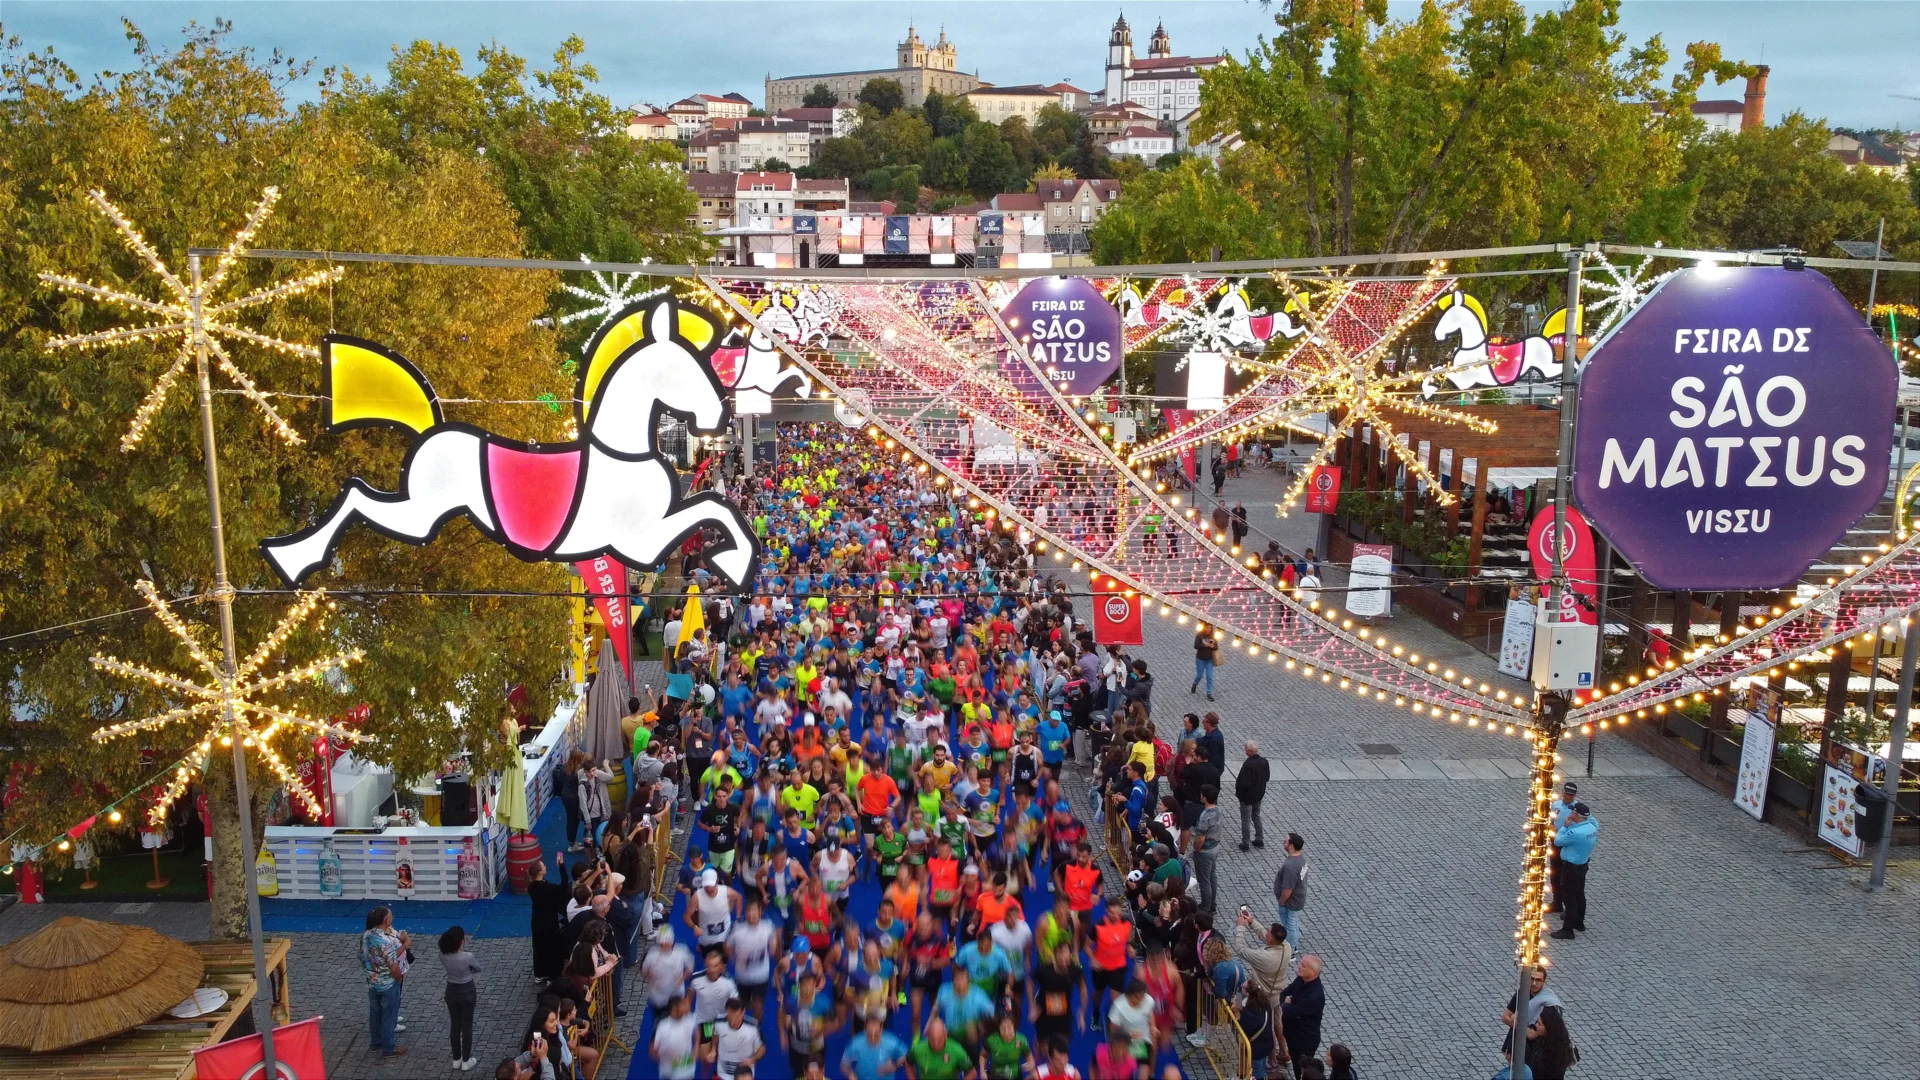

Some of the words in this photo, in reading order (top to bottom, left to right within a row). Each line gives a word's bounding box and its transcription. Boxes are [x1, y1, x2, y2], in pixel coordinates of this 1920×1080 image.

[1032, 301, 1067, 311] FEIRA
[1070, 300, 1085, 311] DE
[1032, 314, 1085, 340] SÃO
[1674, 328, 1762, 354] FEIRA
[1772, 327, 1811, 353] DE
[1046, 370, 1076, 381] ISEU
[1669, 364, 1807, 428] SÃO
[1598, 435, 1866, 489] MATEUS
[1686, 509, 1771, 534] VISEU
